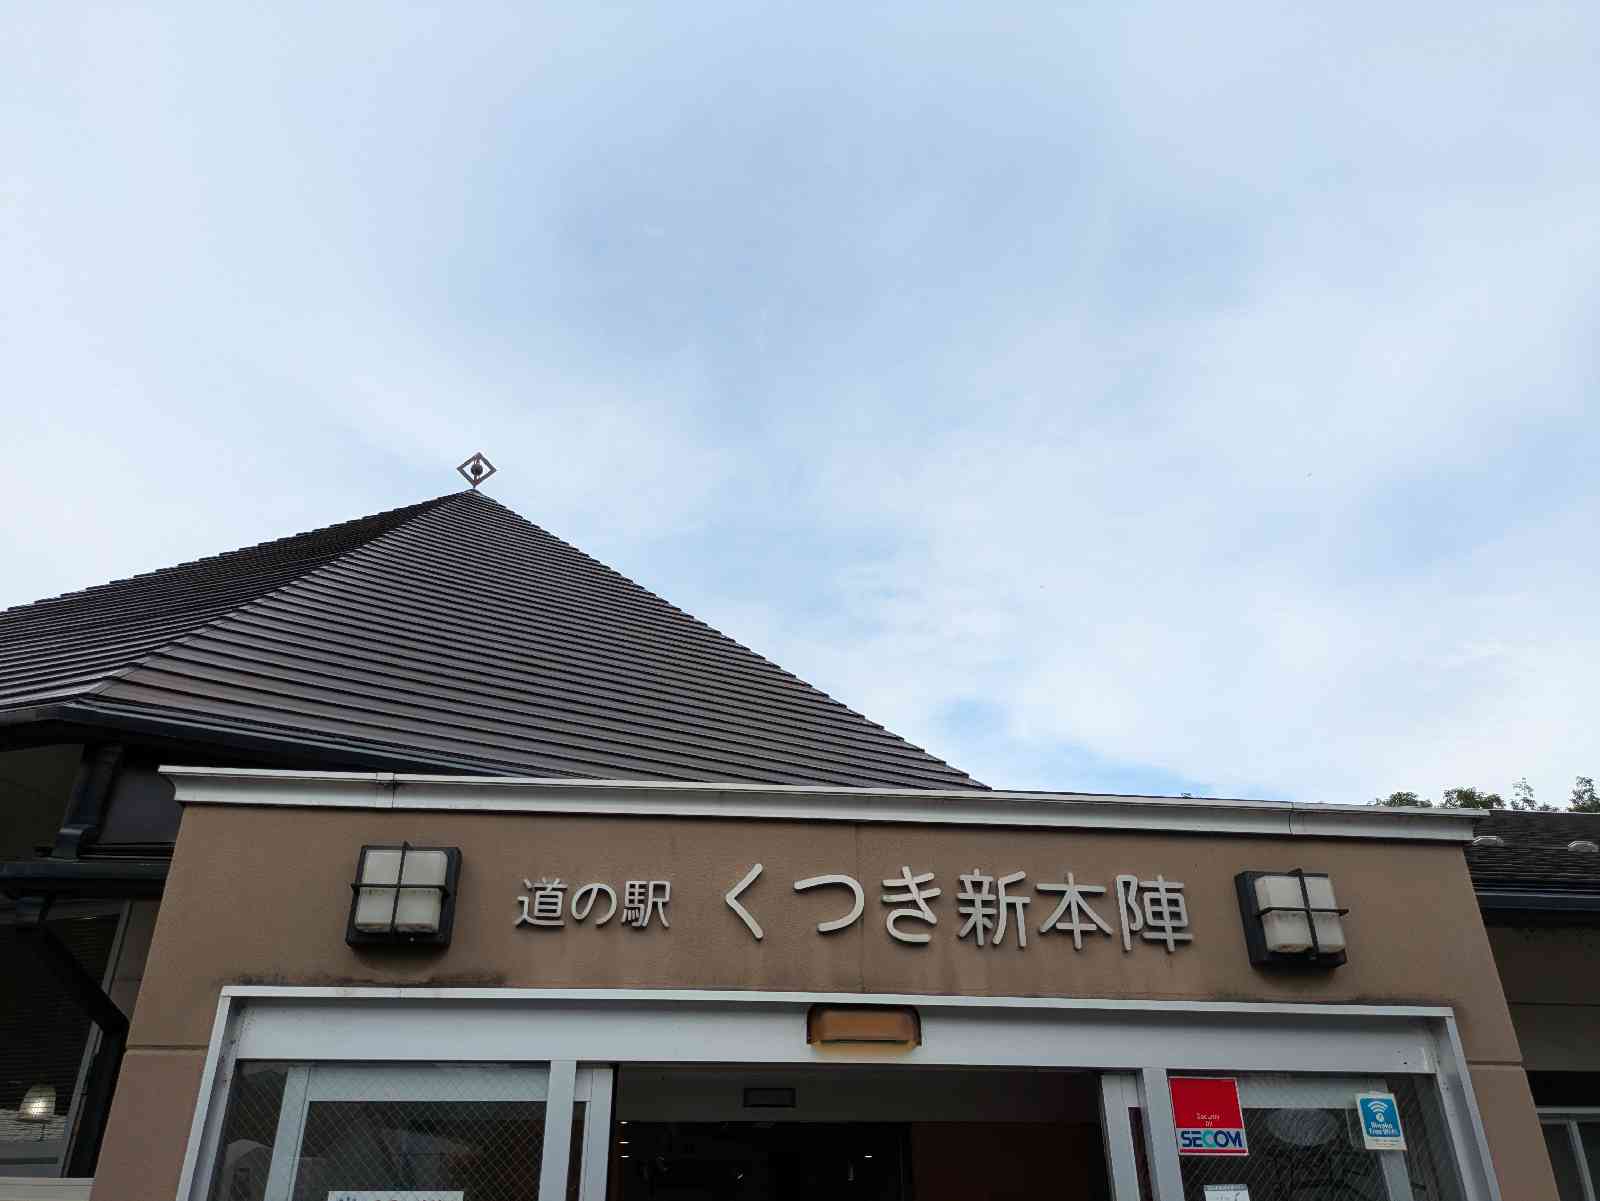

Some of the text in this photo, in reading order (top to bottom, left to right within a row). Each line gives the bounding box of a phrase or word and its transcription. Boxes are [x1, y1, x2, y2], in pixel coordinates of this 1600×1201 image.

[515, 863, 1193, 953] 道の駅 くつき新本陣
[1181, 1129, 1243, 1148] SECOM
